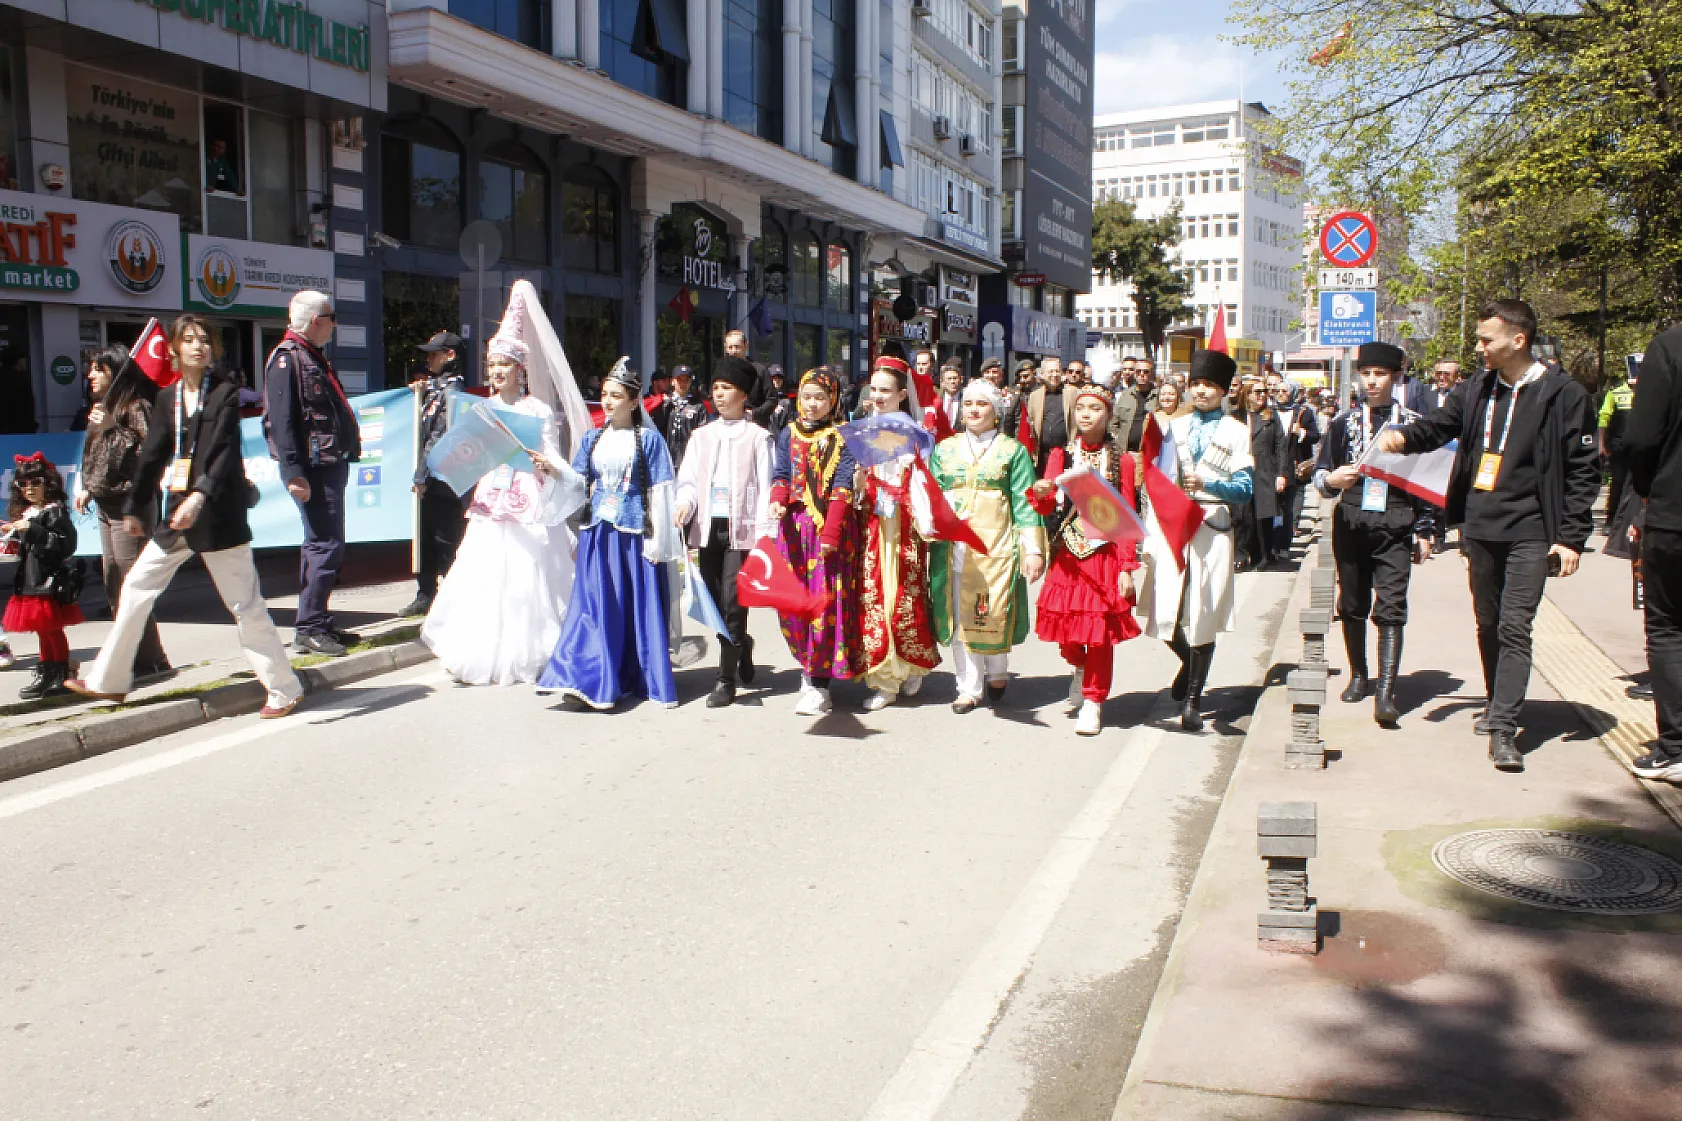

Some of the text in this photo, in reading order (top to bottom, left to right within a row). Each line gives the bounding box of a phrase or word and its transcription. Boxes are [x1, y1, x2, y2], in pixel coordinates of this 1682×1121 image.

[132, 0, 371, 72] PERATİFLERİ
[5, 268, 73, 289] market
[683, 255, 723, 289] HOTEL
[1323, 320, 1371, 328] Elektronik
